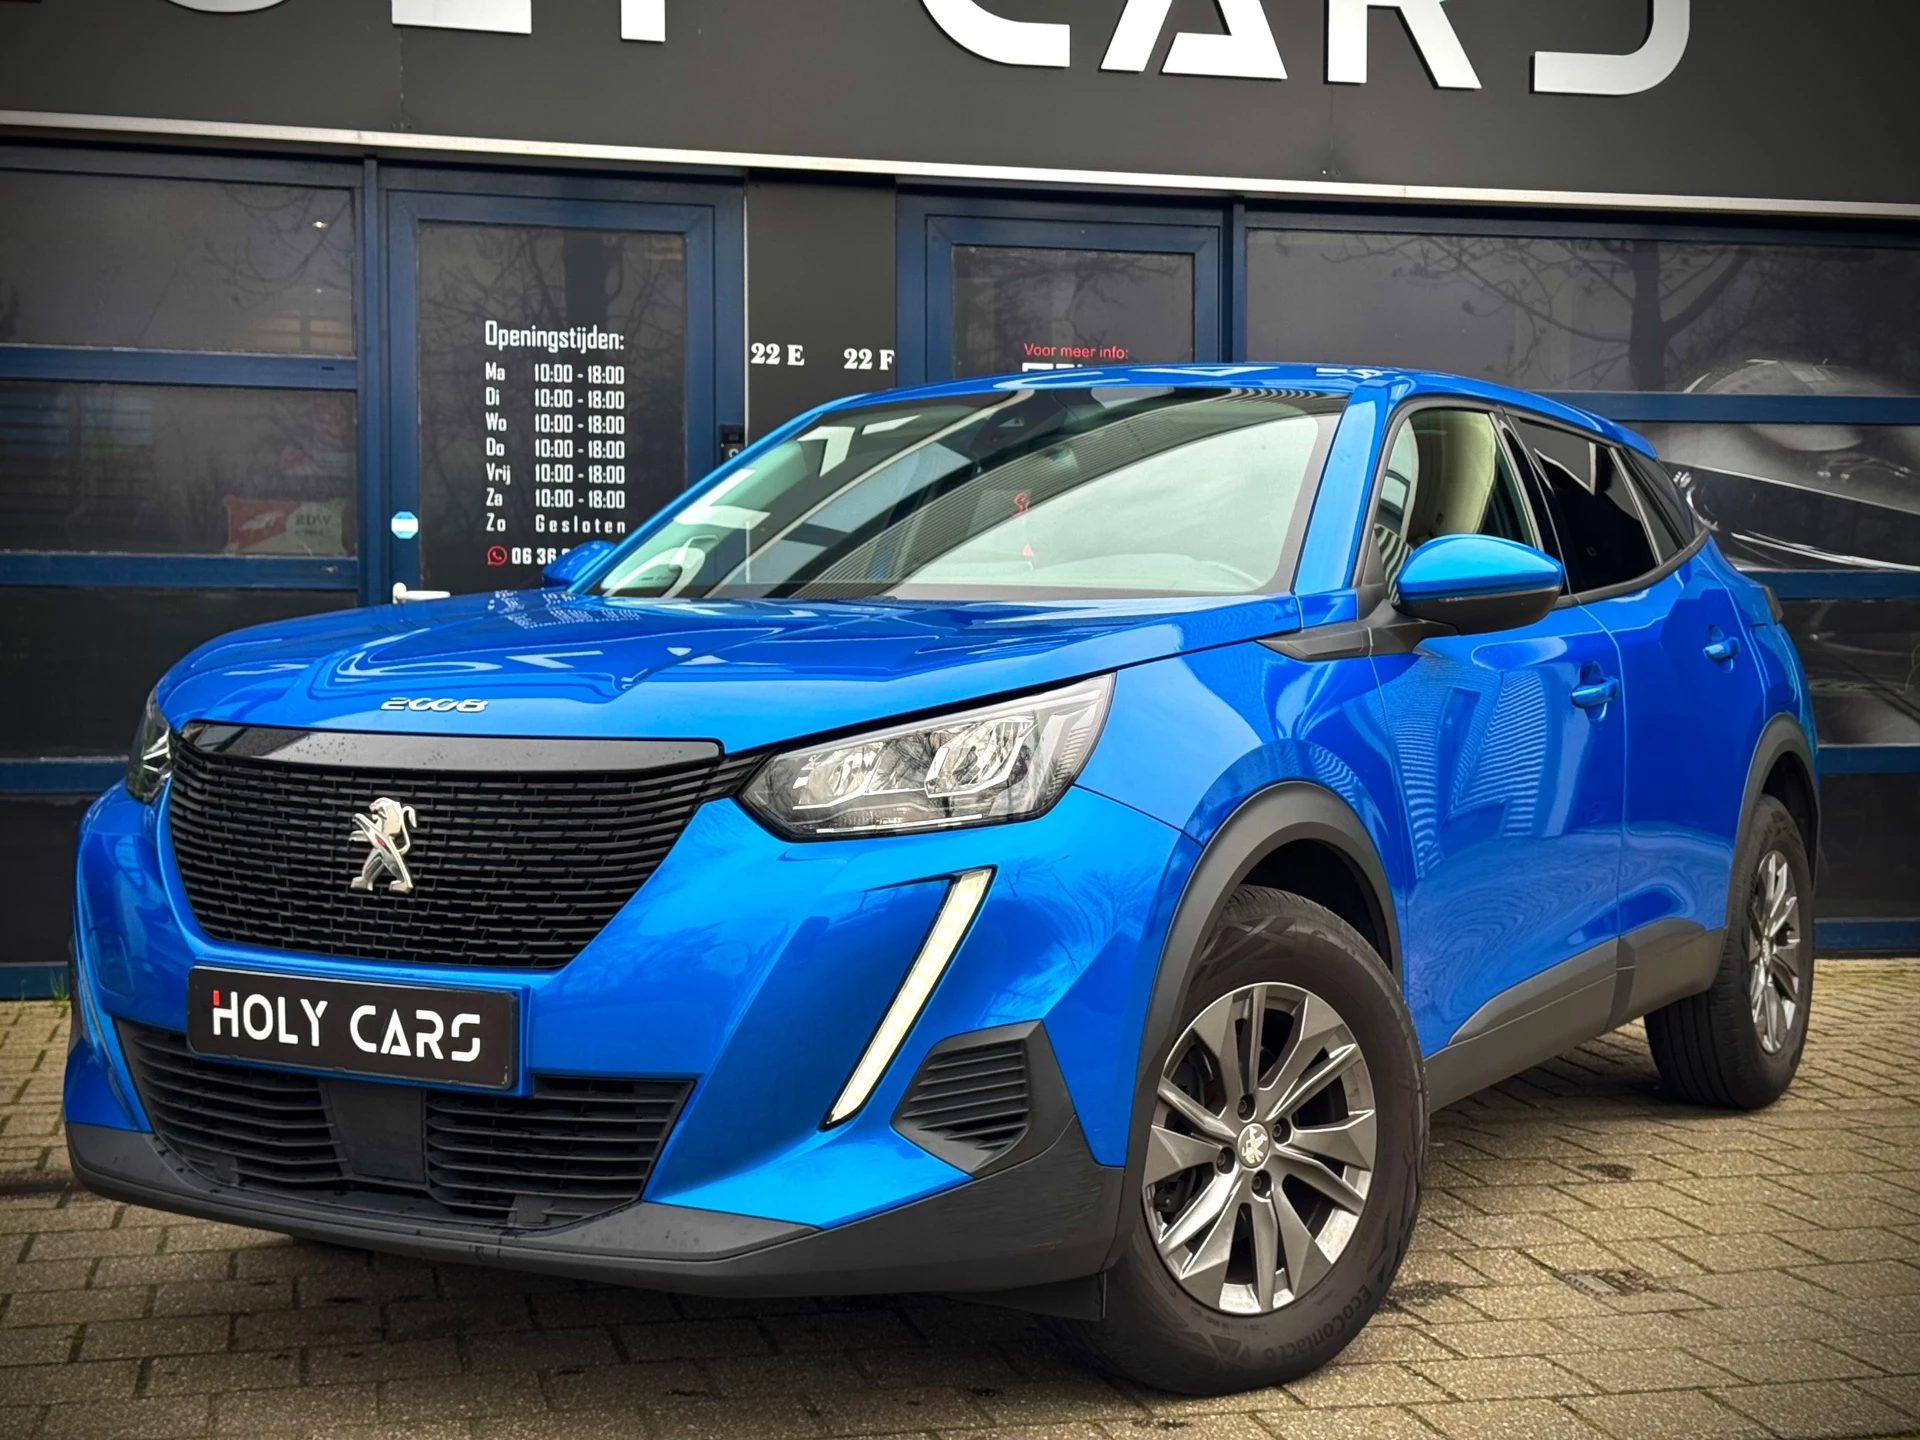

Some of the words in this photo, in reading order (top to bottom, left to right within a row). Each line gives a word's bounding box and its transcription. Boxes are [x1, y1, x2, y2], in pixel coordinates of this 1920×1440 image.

[485, 320, 624, 354] Openingstijden:
[751, 343, 780, 365] 22
[787, 345, 804, 366] E
[844, 348, 872, 369] 22
[880, 350, 894, 370] F
[1024, 343, 1056, 357] Voor
[1060, 346, 1096, 358] meer
[1099, 346, 1128, 359] info:
[486, 362, 505, 381] Ma
[535, 364, 572, 383] 10:00
[588, 365, 624, 384] 18:00
[486, 387, 499, 405] Di
[535, 389, 572, 408] 10:00
[588, 390, 624, 409] 18:00
[486, 412, 507, 431] Wo
[535, 414, 573, 433] 10:00
[588, 415, 624, 434] 18:00
[486, 437, 504, 456] Do
[535, 439, 573, 458] 10:00
[588, 440, 625, 459] 18:00
[486, 462, 511, 485] Vrij
[535, 464, 573, 483] 10:00
[589, 465, 625, 484] 18:00
[486, 488, 502, 506] Za
[536, 489, 573, 507] 10:00
[589, 490, 625, 508] 18:00
[486, 513, 505, 531] Zo
[512, 548, 531, 564] 06
[381, 696, 489, 712] 2008
[213, 990, 327, 1046] HOLY
[350, 1005, 480, 1062] CARS
[1279, 1284, 1372, 1359] EcoContact
